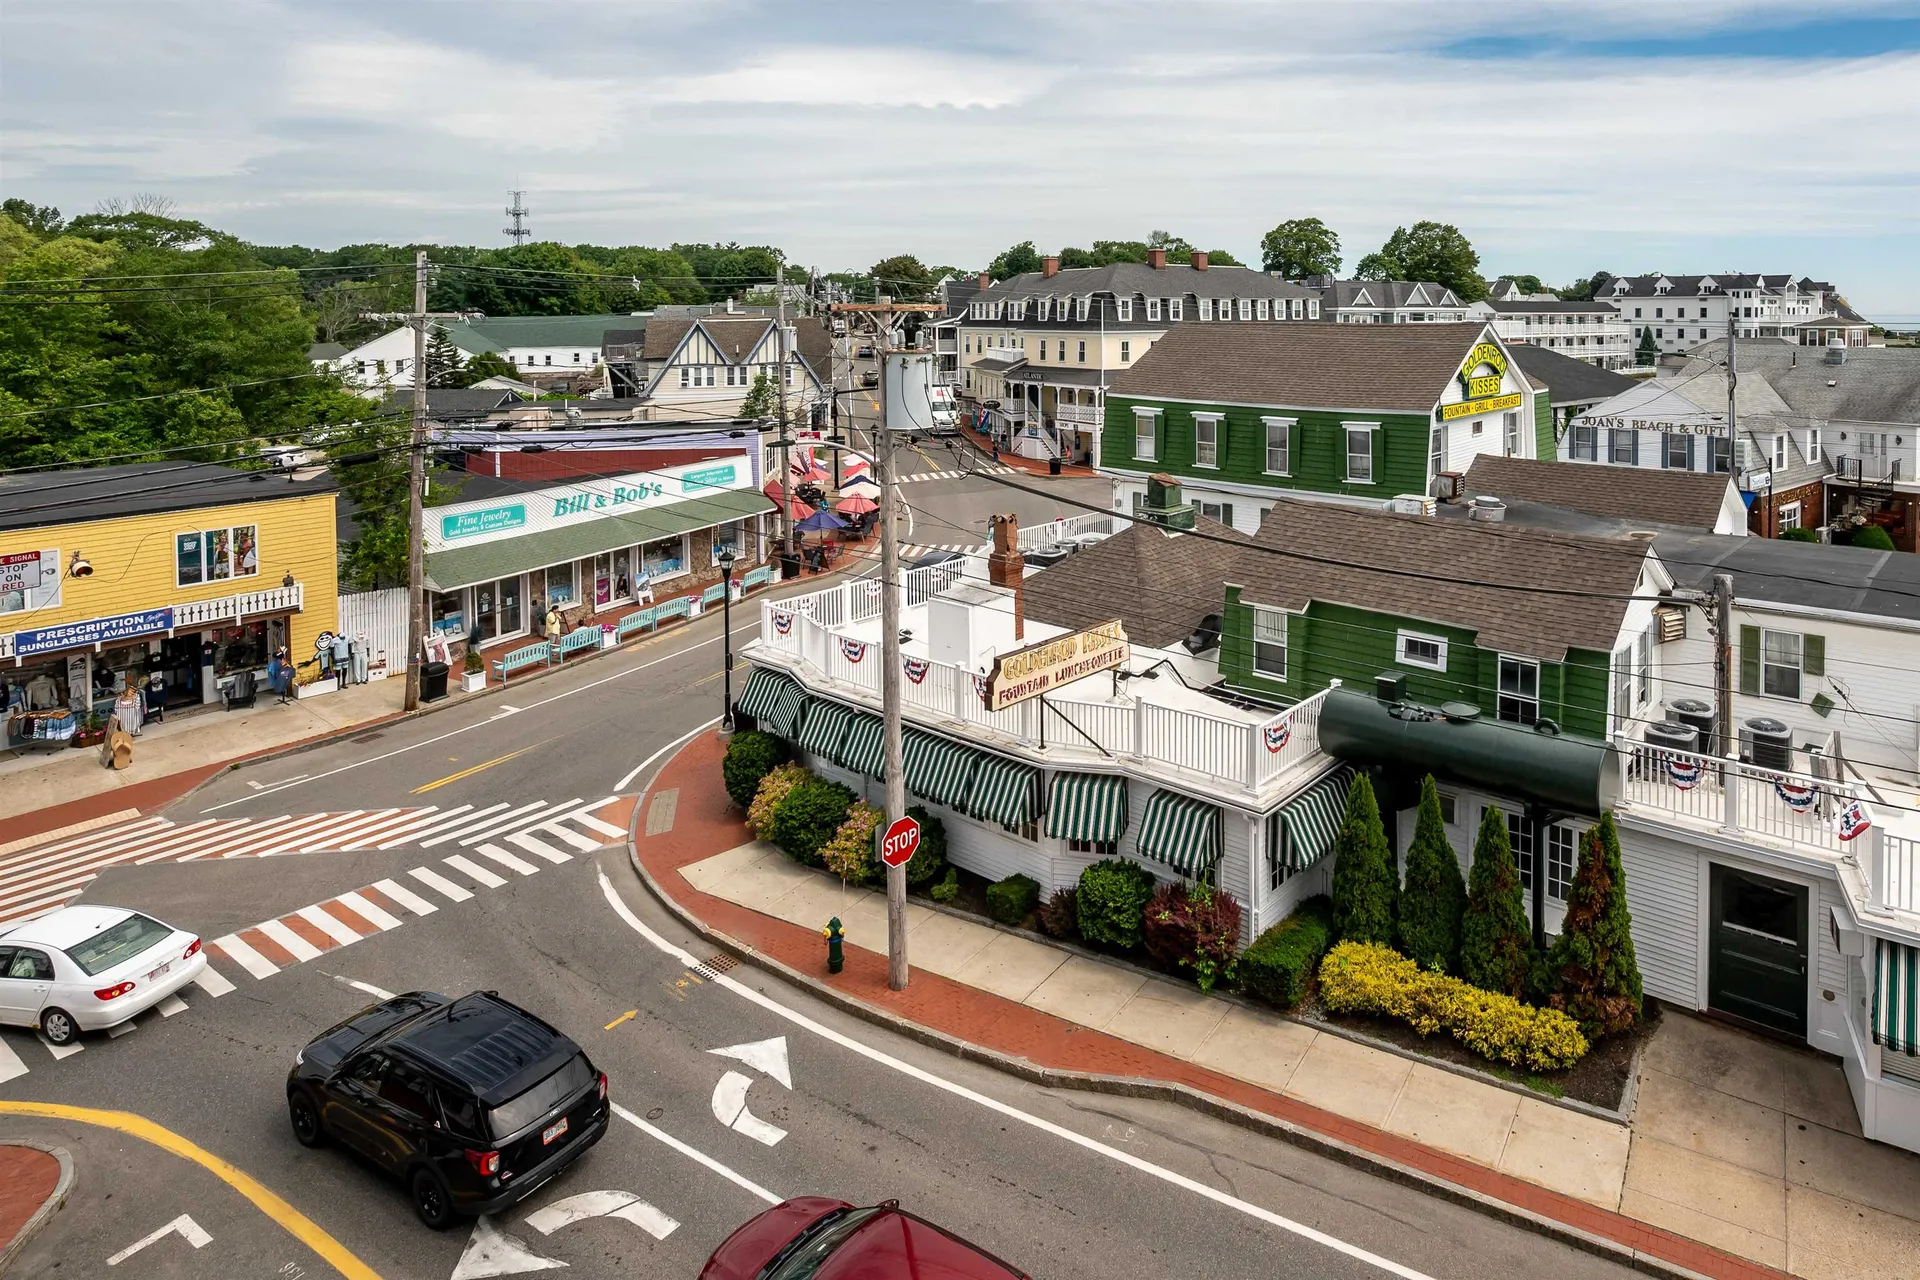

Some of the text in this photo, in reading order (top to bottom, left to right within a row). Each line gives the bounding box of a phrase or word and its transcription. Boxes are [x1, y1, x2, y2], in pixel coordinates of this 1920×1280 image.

[1463, 346, 1505, 377] GOLDENROD
[1470, 378, 1498, 395] KISSES
[1444, 396, 1519, 418] FOUNTAIN GRILL BREAKFAST
[1582, 416, 1725, 436] JOAN'S BEACH & GIFT
[553, 492, 590, 517] Bill
[594, 494, 607, 508] &
[612, 481, 662, 505] Bob's
[457, 510, 511, 527] Fine Jewelry
[462, 526, 479, 534] Jewelry
[0, 563, 28, 574] STOP
[10, 553, 37, 563] SIGNAL
[2, 581, 25, 591] RED
[5, 574, 21, 582] ON
[19, 621, 164, 653] SUNGLASSES AVAILABLE
[36, 616, 144, 641] PRESCRIPTION
[1003, 622, 1120, 680] GOLDENROD KISSES
[999, 646, 1124, 704] FOUNTAIN LUNCHEONETTE
[885, 828, 917, 856] STOP
